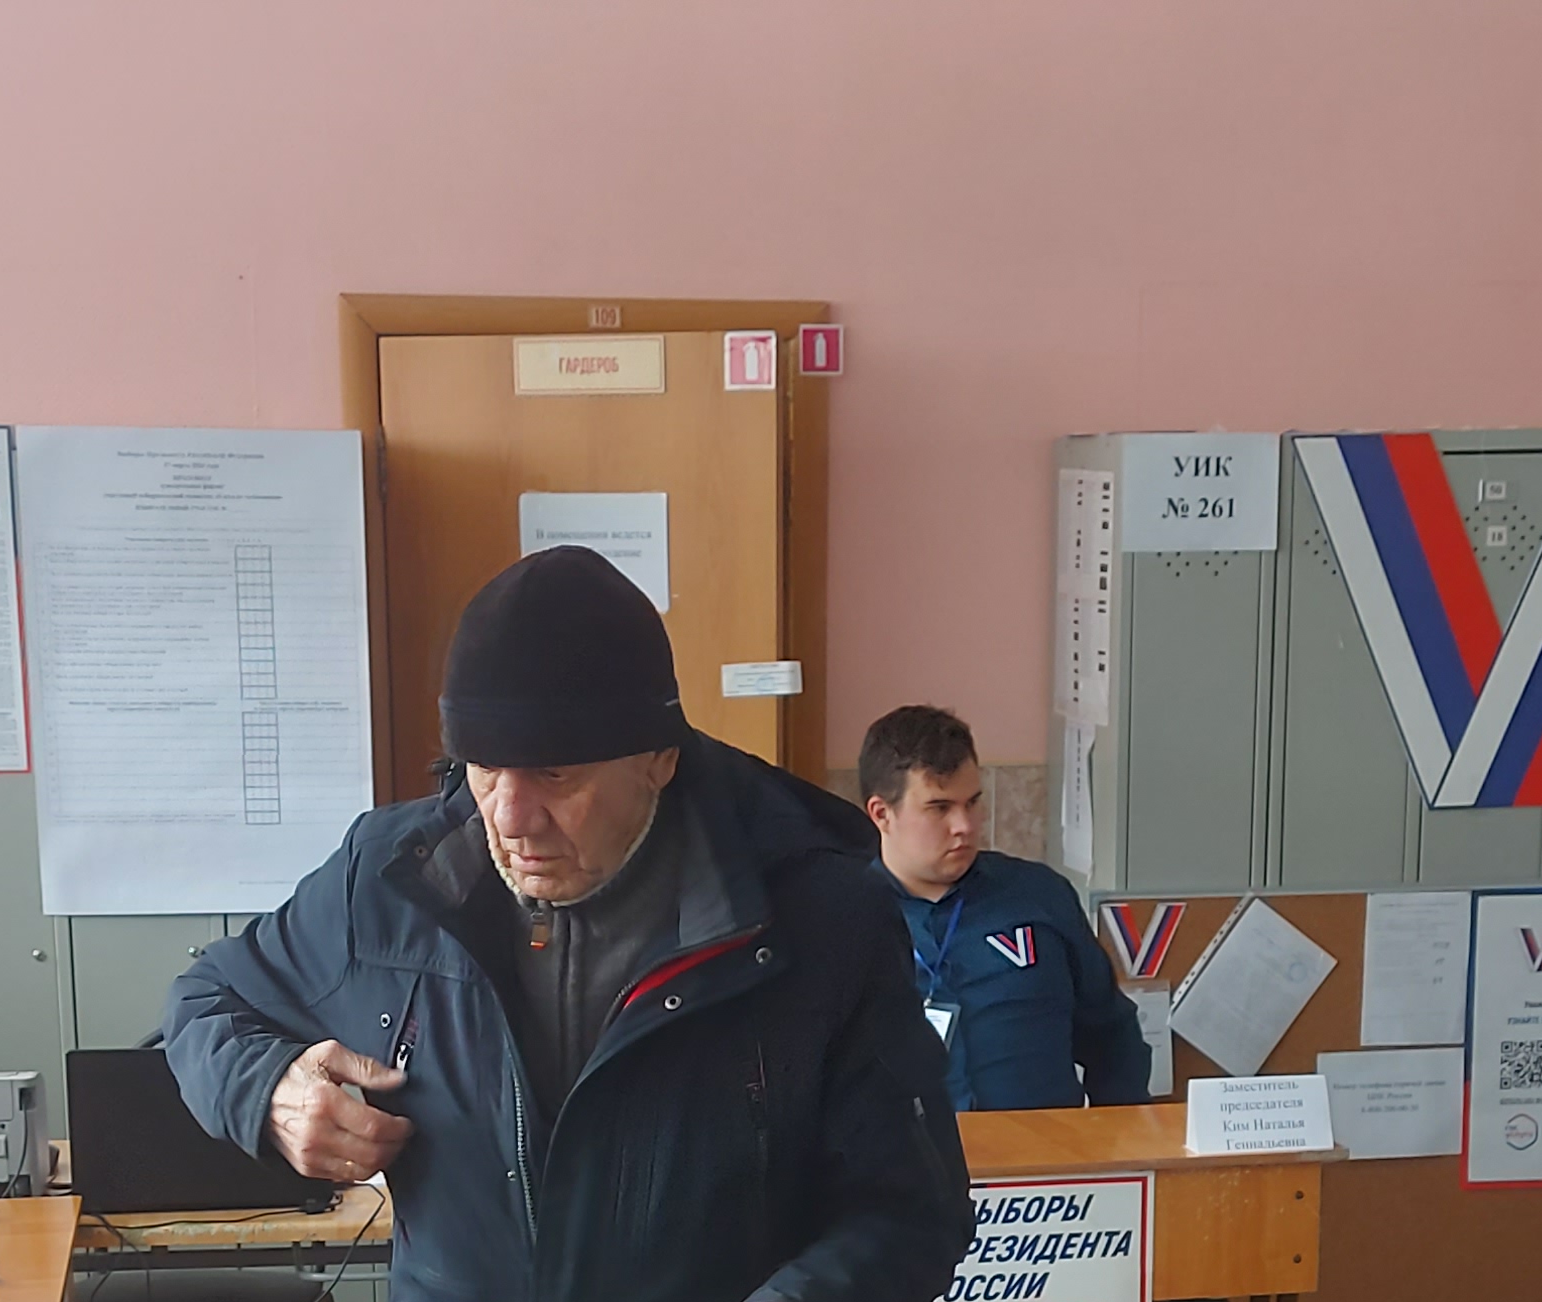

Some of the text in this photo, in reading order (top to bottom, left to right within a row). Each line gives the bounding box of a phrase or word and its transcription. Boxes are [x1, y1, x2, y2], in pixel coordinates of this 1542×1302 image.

[594, 307, 617, 326] 109
[558, 355, 620, 375] ГАРДЕРОБ
[1172, 455, 1233, 478] УИК
[1161, 496, 1235, 519] № 261
[1219, 1080, 1300, 1094] Заместитель
[1219, 1098, 1304, 1115] председателя
[1222, 1117, 1306, 1134] Ким Наталья
[1225, 1136, 1307, 1151] Геннадьевна
[976, 1193, 1095, 1225] ЫБОРЫ
[966, 1229, 1134, 1265] РЕЗИДЕНТА
[942, 1271, 1051, 1302] ОССИИ
